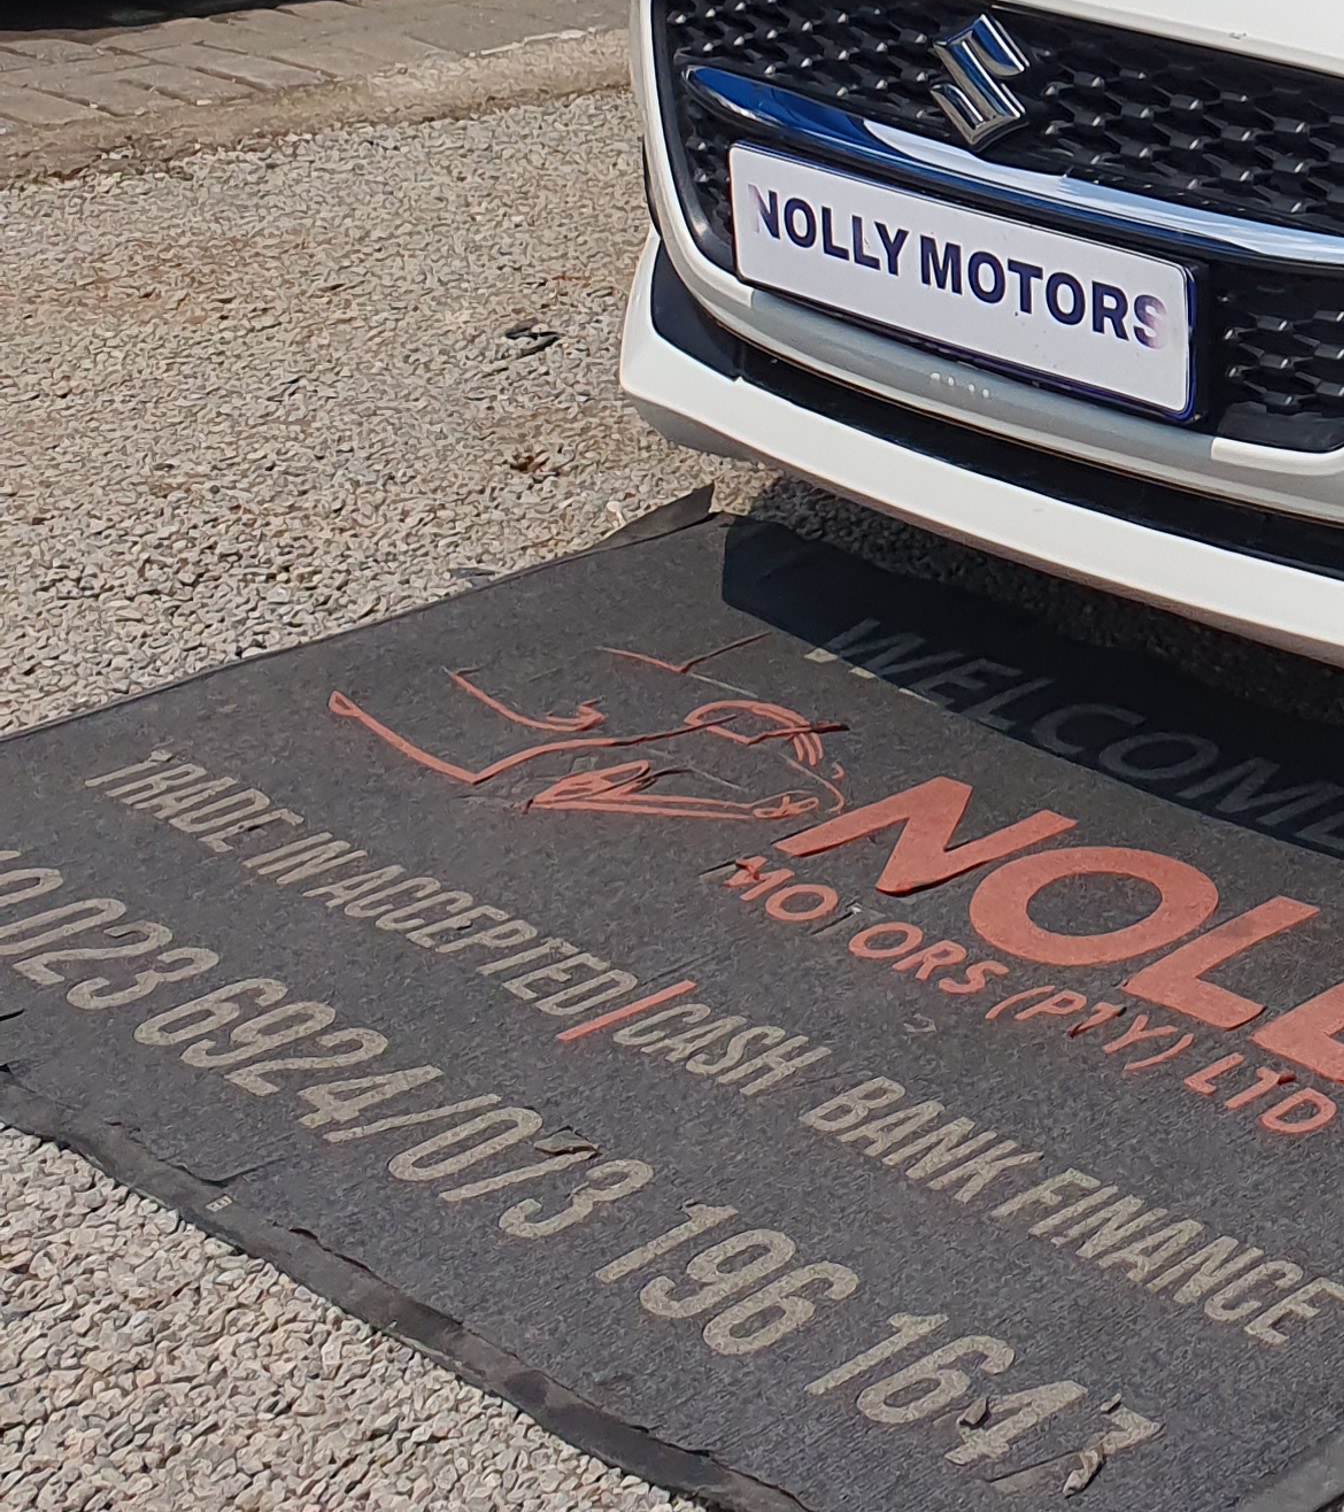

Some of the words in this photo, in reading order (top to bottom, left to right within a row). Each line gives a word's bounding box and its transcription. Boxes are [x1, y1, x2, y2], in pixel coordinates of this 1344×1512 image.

[747, 182, 909, 276] NOLLY
[919, 235, 1168, 350] MOTORS
[84, 748, 304, 854] TRADE
[800, 1075, 1044, 1203] BANK
[1183, 1051, 1337, 1135] LTD
[595, 1200, 859, 1357] 196
[803, 1311, 1166, 1498] 1647
